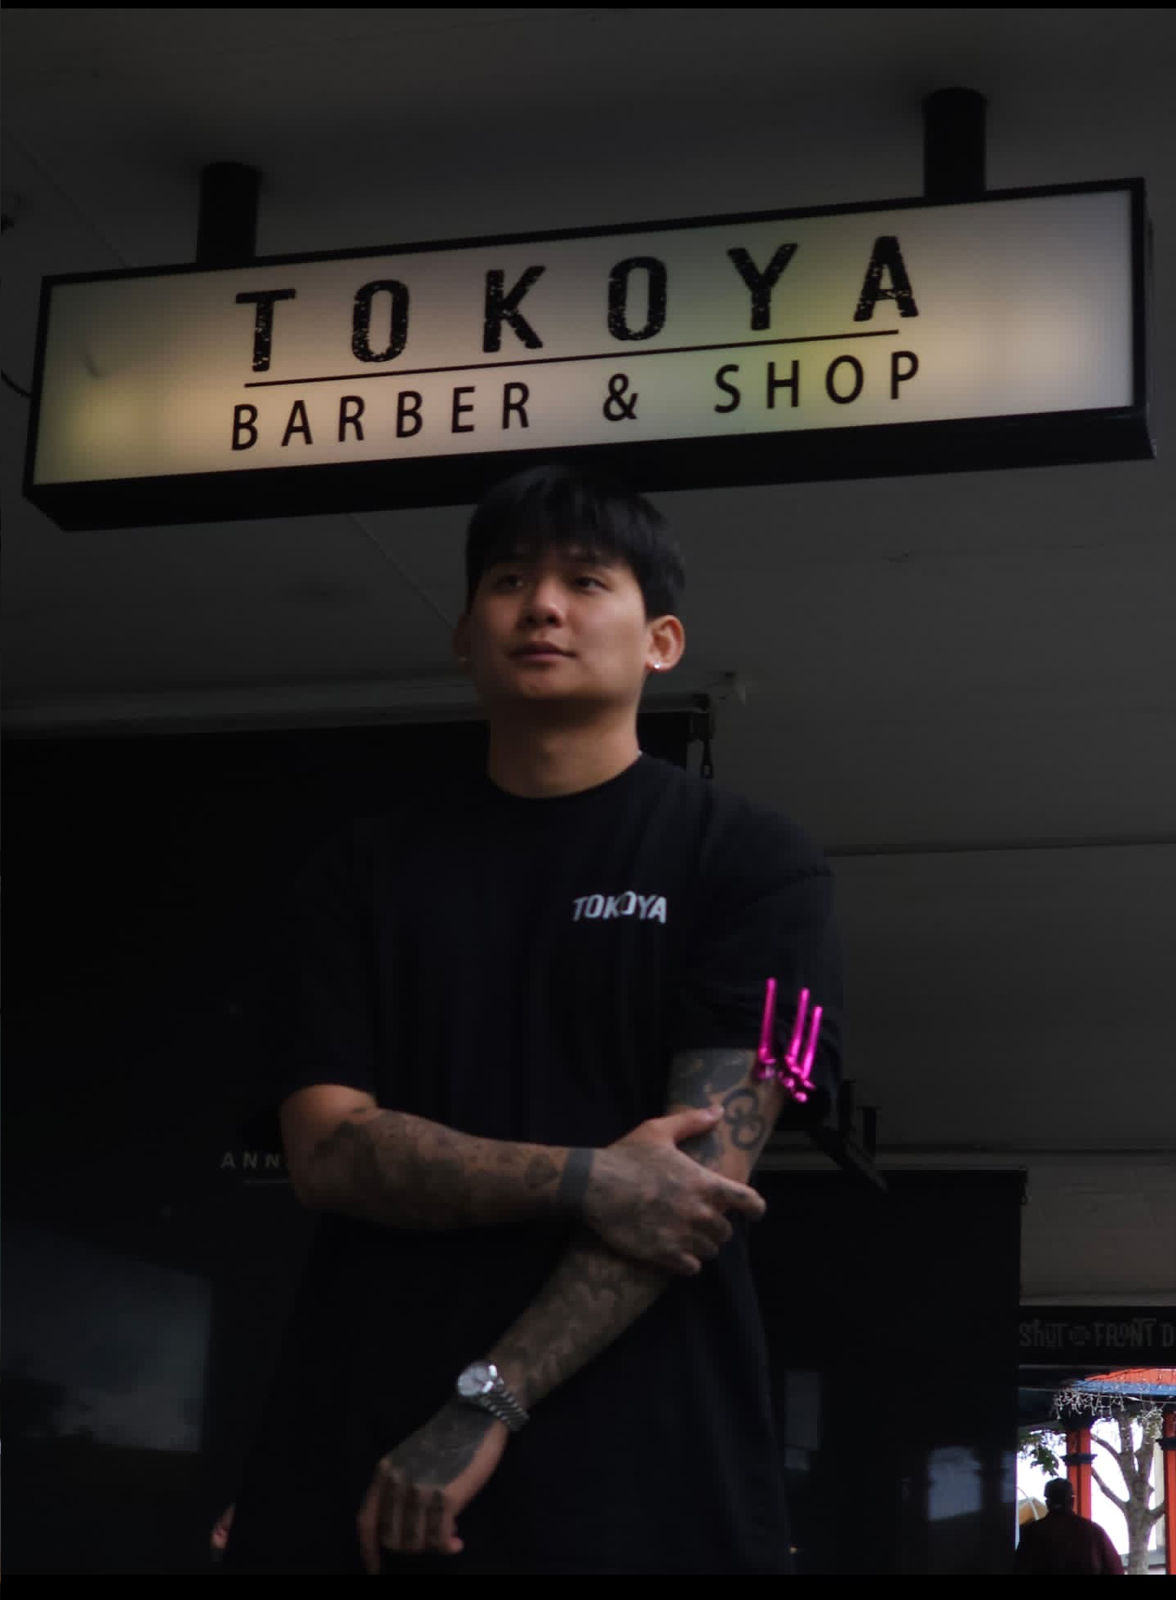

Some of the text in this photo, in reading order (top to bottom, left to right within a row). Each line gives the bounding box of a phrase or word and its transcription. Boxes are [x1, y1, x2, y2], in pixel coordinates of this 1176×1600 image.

[235, 236, 918, 371] TOKOYA
[232, 351, 919, 450] BARBER & SHOP
[572, 890, 668, 925] TOKOYA
[220, 1151, 287, 1170] ANN
